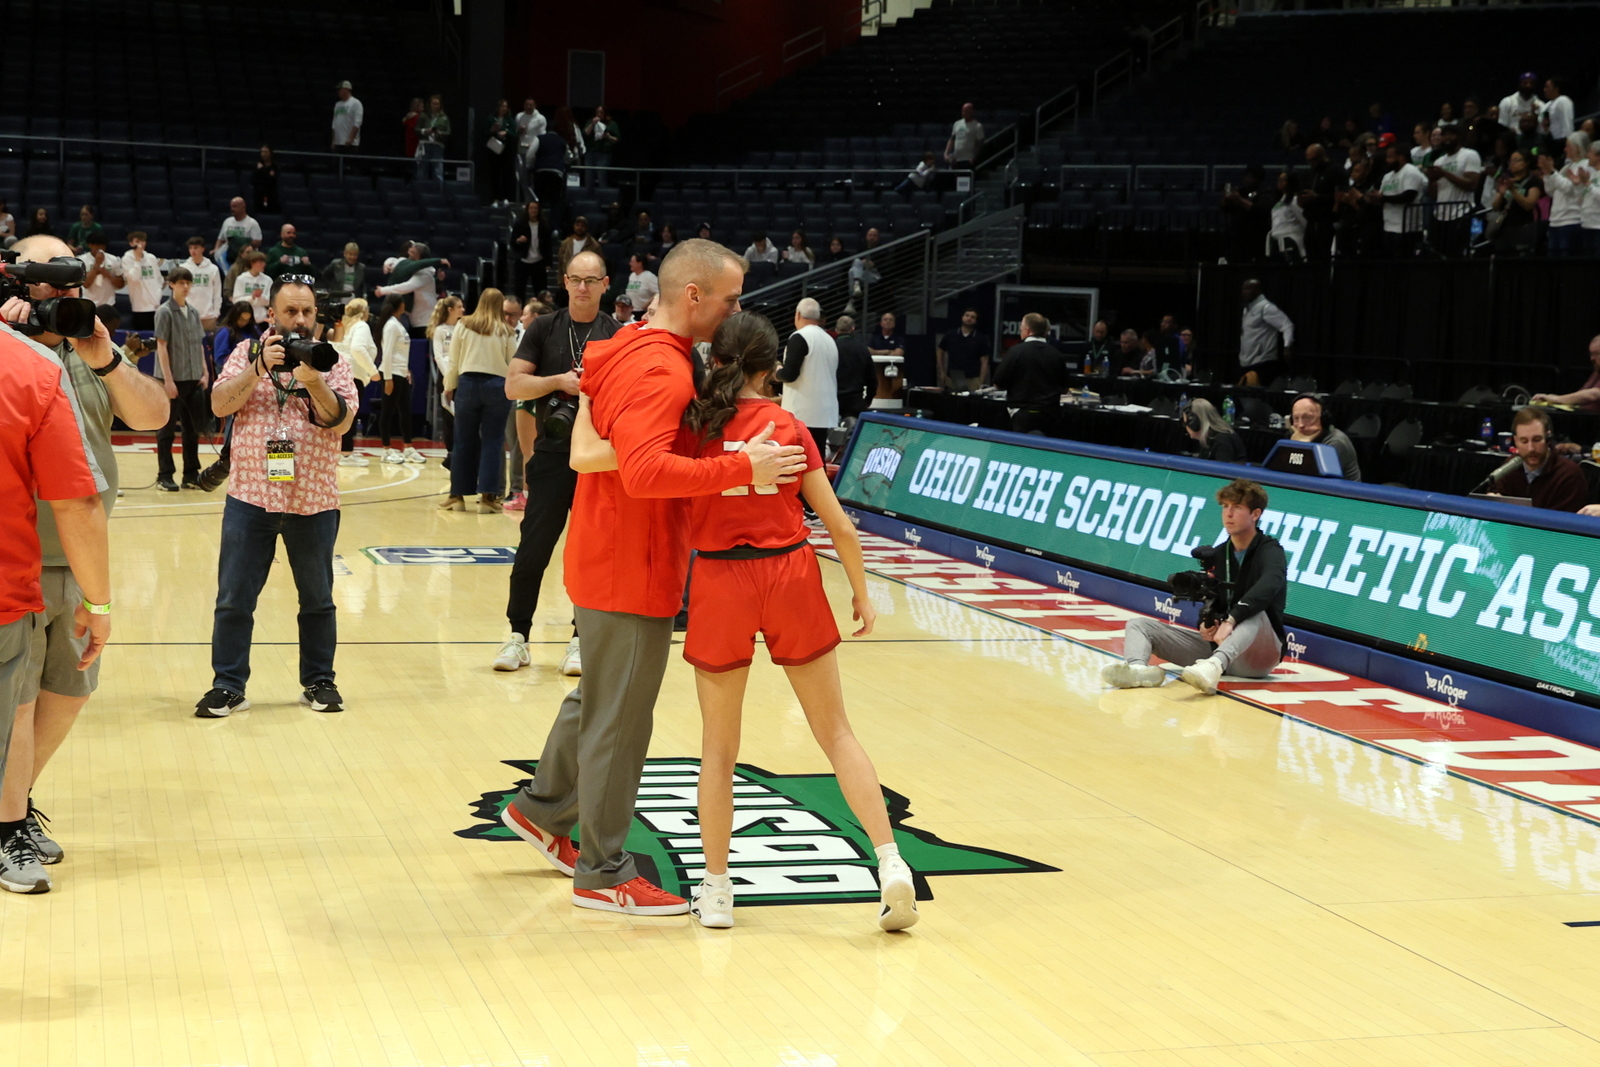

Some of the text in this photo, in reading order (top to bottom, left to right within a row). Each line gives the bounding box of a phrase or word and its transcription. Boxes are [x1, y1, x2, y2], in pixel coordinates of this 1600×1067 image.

[861, 447, 902, 481] OHSAA
[908, 448, 981, 505] OHIO
[973, 460, 1063, 524] HIGH
[1055, 475, 1207, 558] SCHOOL
[1212, 509, 1480, 618] THLETIC
[1063, 571, 1081, 594] Kroger
[1161, 598, 1183, 622] Kroger
[1437, 674, 1468, 706] Kroger
[1536, 682, 1576, 697] DAKTRONICS
